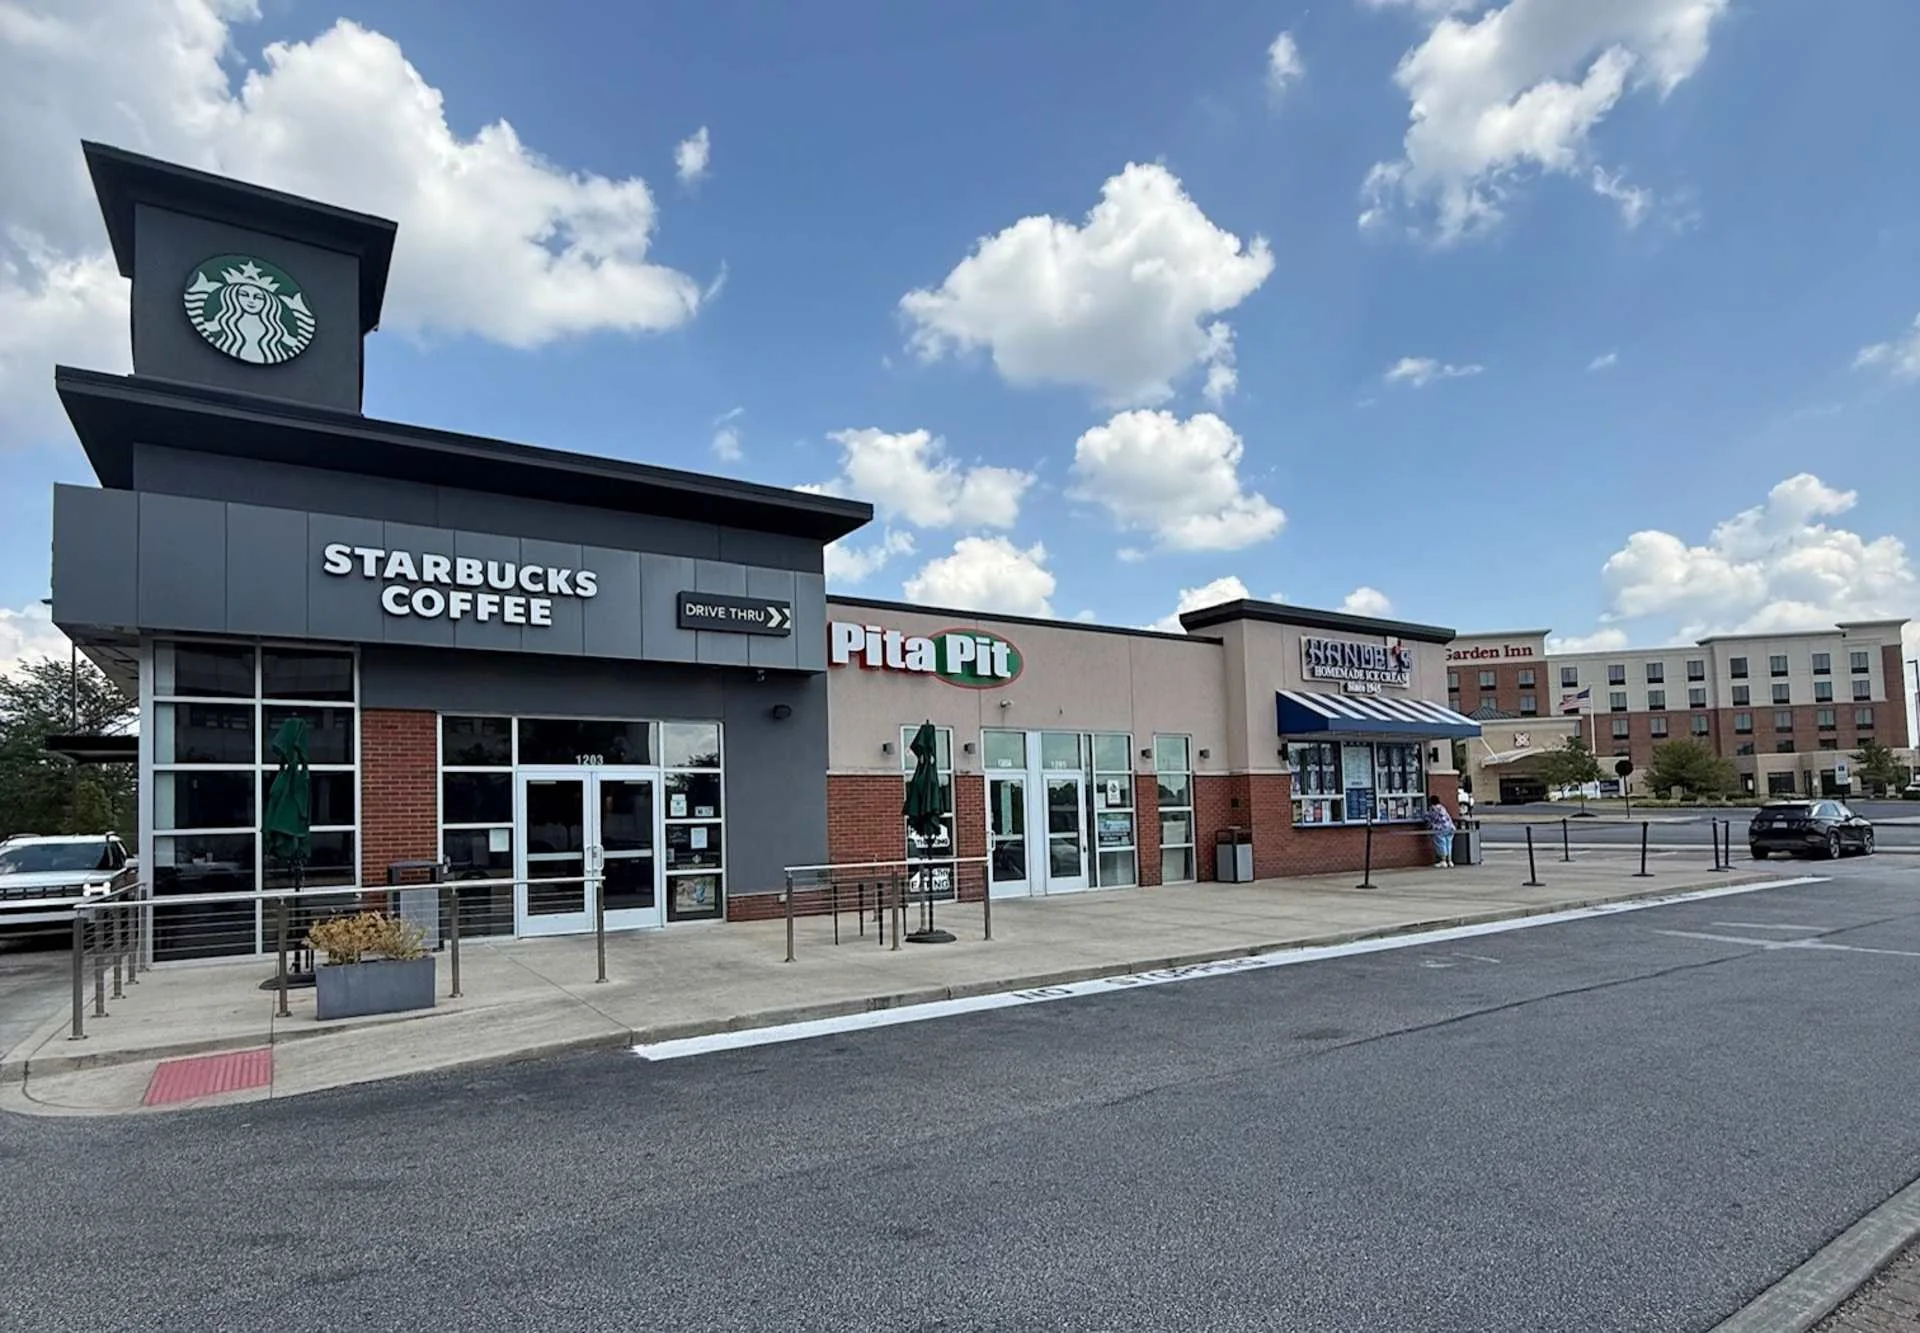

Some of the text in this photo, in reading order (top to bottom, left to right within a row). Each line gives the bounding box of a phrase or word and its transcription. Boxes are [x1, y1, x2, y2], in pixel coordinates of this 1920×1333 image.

[324, 543, 598, 598] STARBUCKS
[381, 585, 552, 626] COFFEE
[685, 603, 765, 622] DRIVE THRU
[830, 621, 1012, 679] Pita Pit
[1504, 643, 1534, 657] Inn
[1314, 664, 1410, 683] HOMEMADE ICE CREAM
[575, 753, 604, 767] 1203
